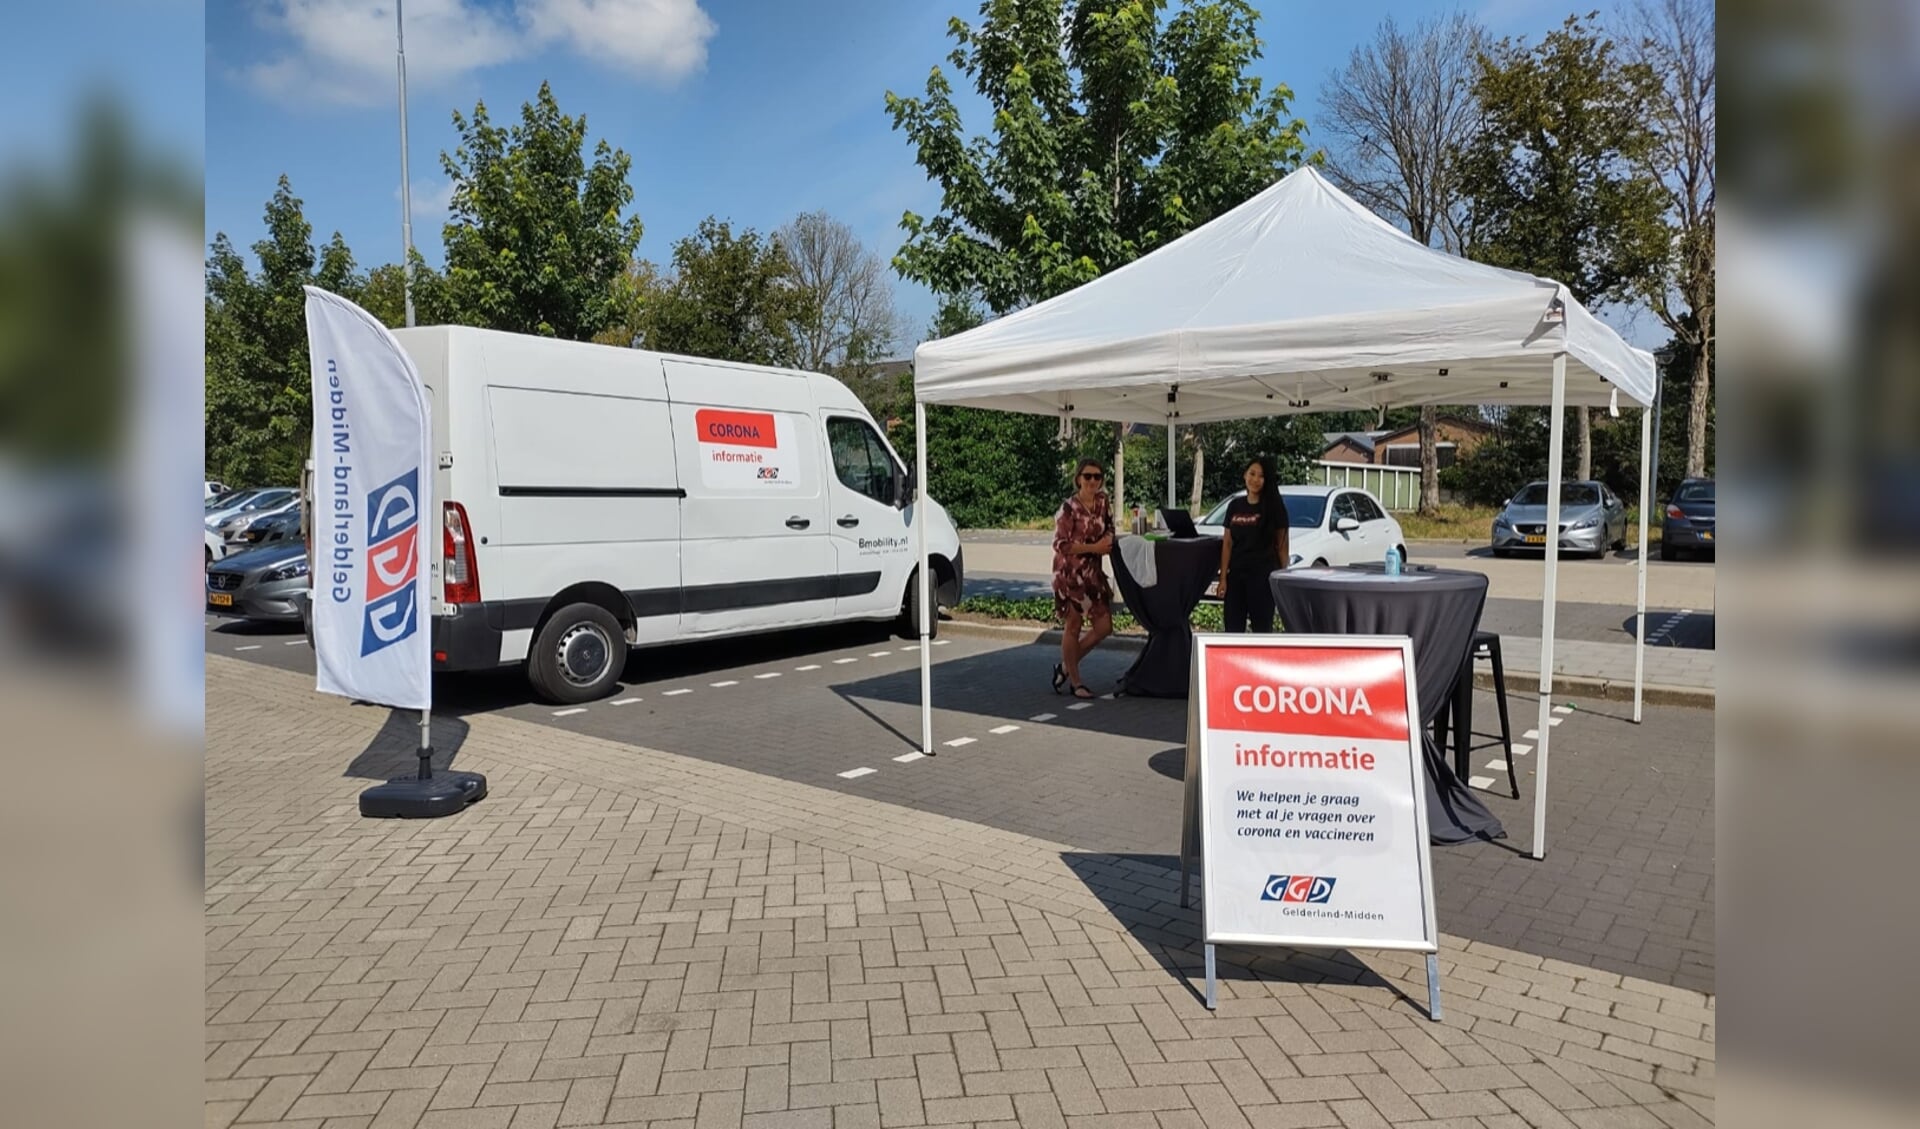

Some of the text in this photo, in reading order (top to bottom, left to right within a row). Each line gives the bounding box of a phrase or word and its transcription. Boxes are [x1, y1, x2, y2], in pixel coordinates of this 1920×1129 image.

[709, 423, 761, 439] CORONA
[712, 450, 763, 463] informatie
[859, 536, 908, 549] Bmobility.nl
[1233, 684, 1373, 716] CORONA
[1235, 743, 1375, 770] informatie
[1237, 790, 1360, 807] We helpen je graag
[1236, 808, 1375, 824] met al je vragen over
[1237, 826, 1374, 842] corona en vaccineren
[1263, 875, 1335, 903] GGD
[1282, 907, 1384, 921] Gelderland-Midden
